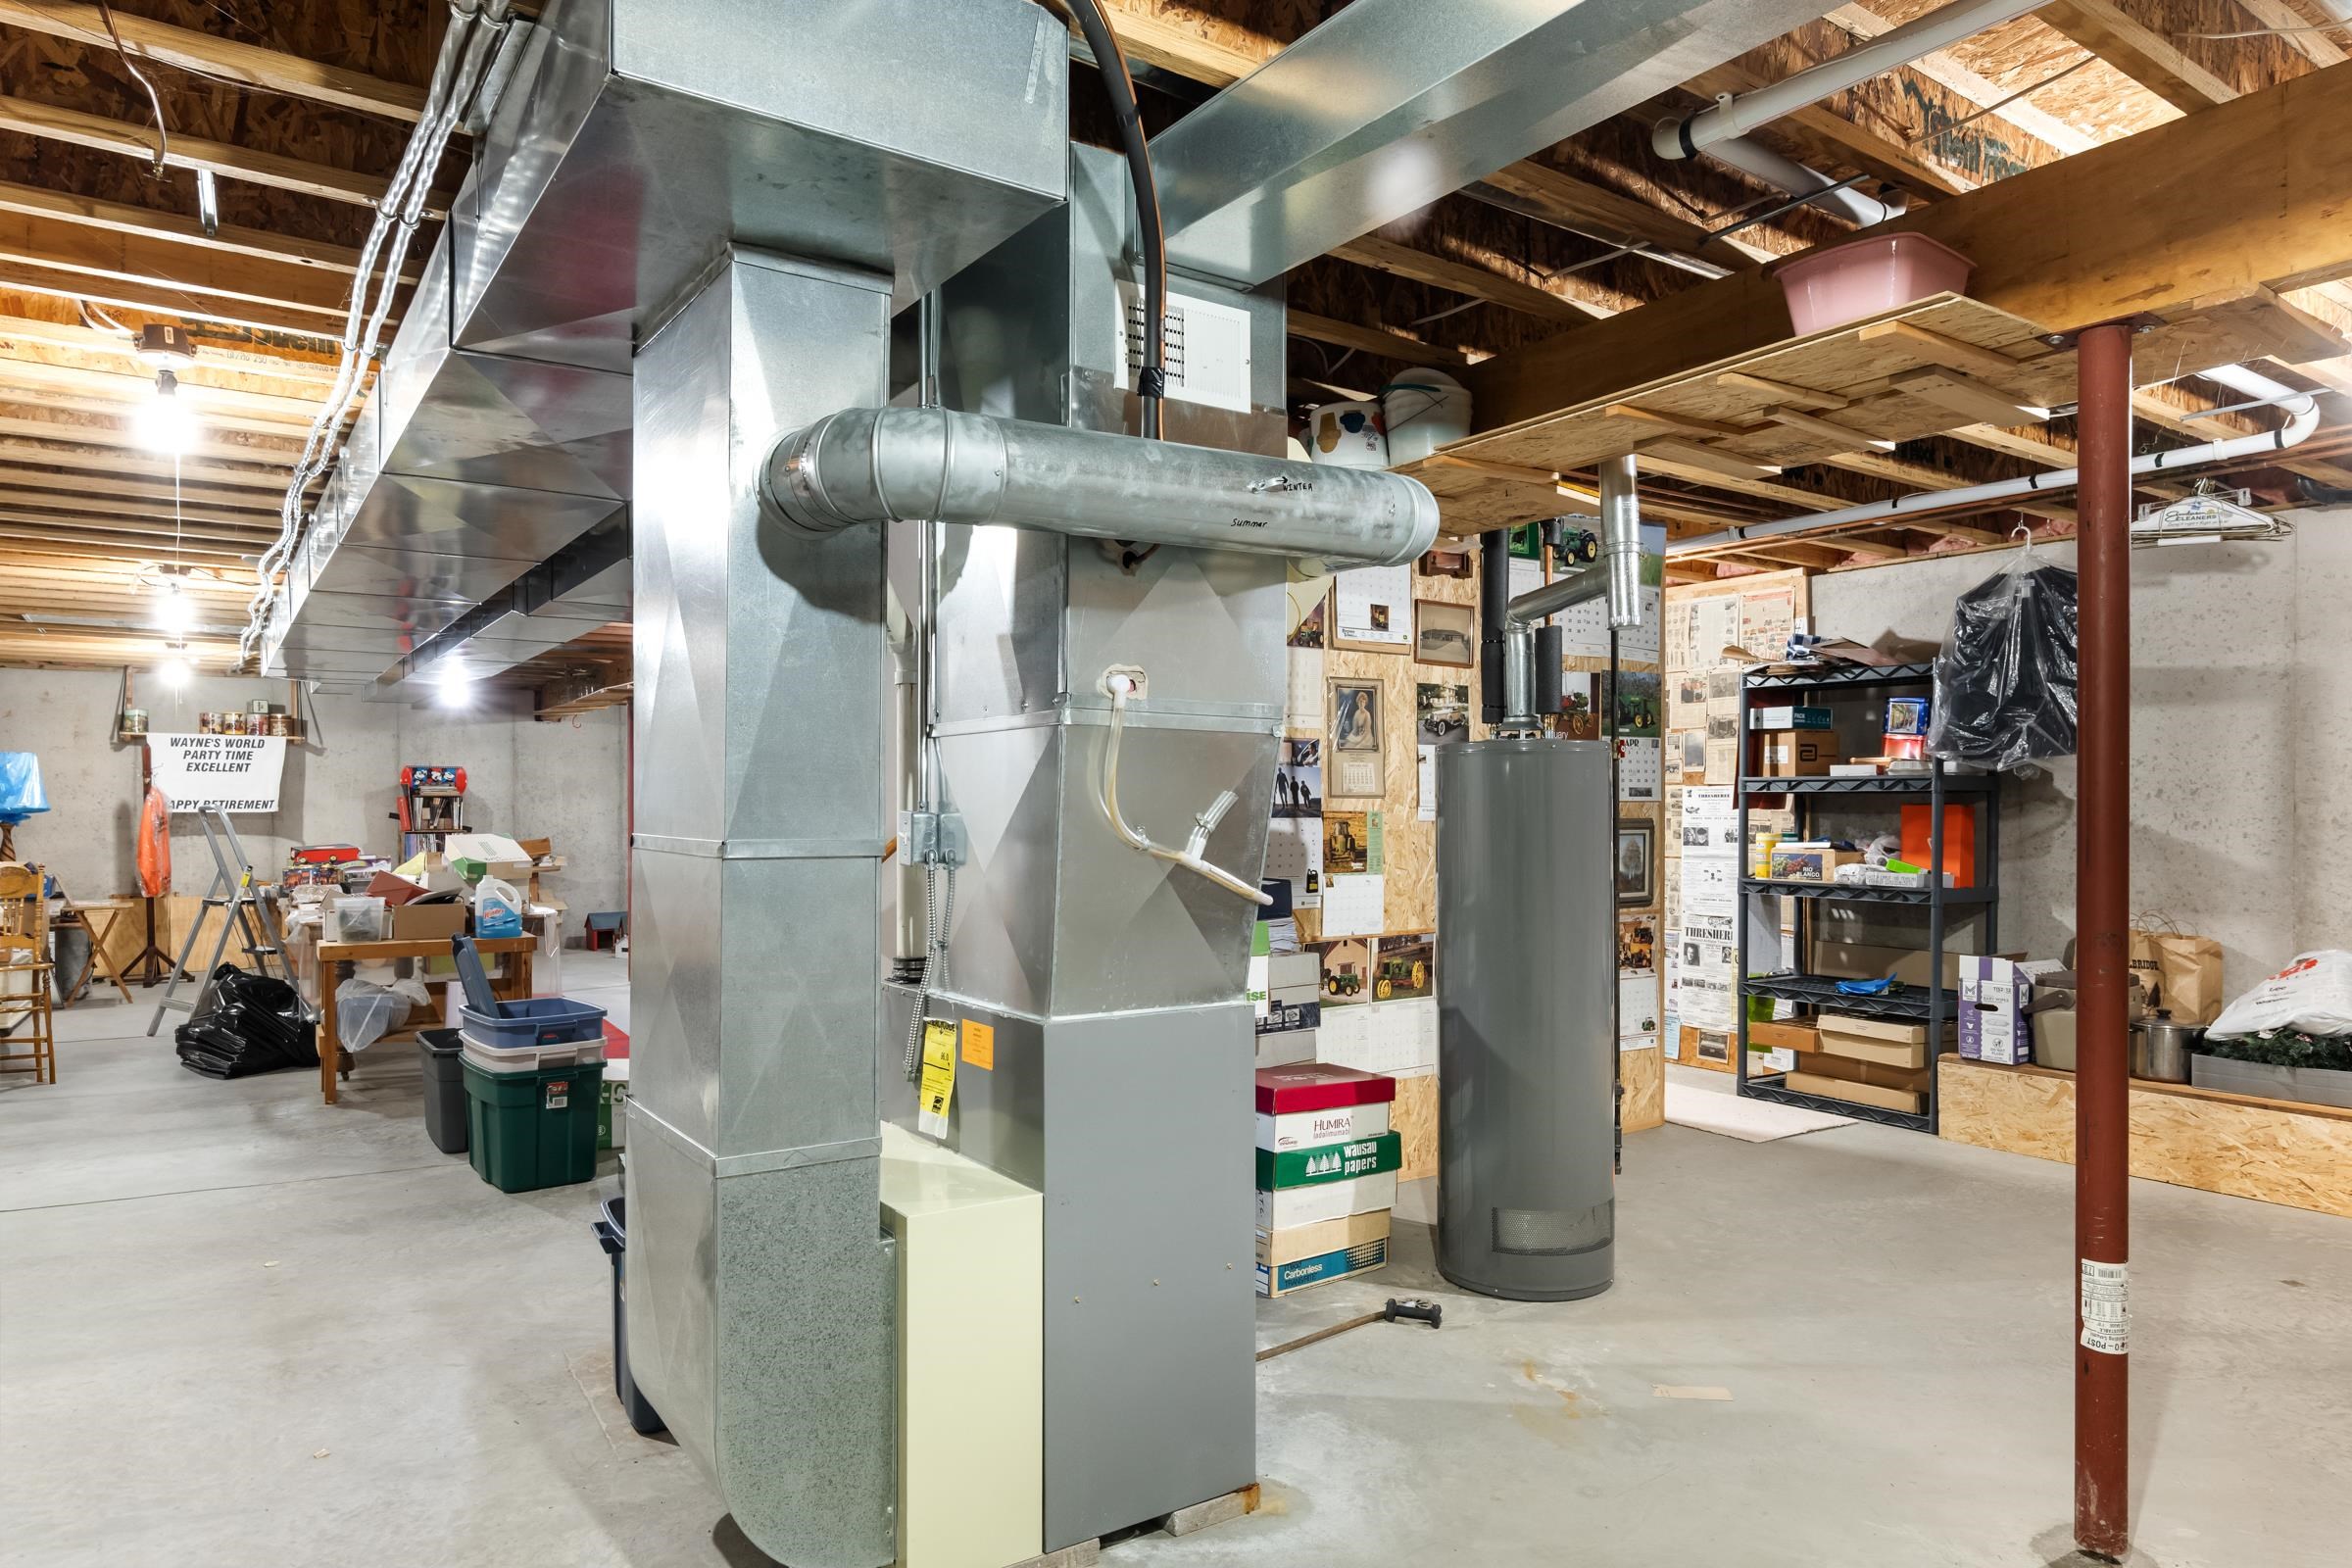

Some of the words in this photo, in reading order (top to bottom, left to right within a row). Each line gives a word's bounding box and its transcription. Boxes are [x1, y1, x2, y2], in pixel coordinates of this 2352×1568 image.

[1283, 483, 1312, 492] WINTER
[1231, 518, 1267, 527] Summer
[170, 737, 221, 748] WAYNE'S
[225, 738, 266, 749] WORLD
[182, 750, 221, 760] PARTY
[225, 751, 254, 760] TIME
[186, 762, 252, 772] EXCELLENT
[171, 800, 200, 809] APPY
[1314, 1118, 1350, 1131] HUMIRA
[1344, 1142, 1377, 1157] wausau
[1345, 1157, 1377, 1176] papers
[1284, 1263, 1323, 1280] Carbonless
